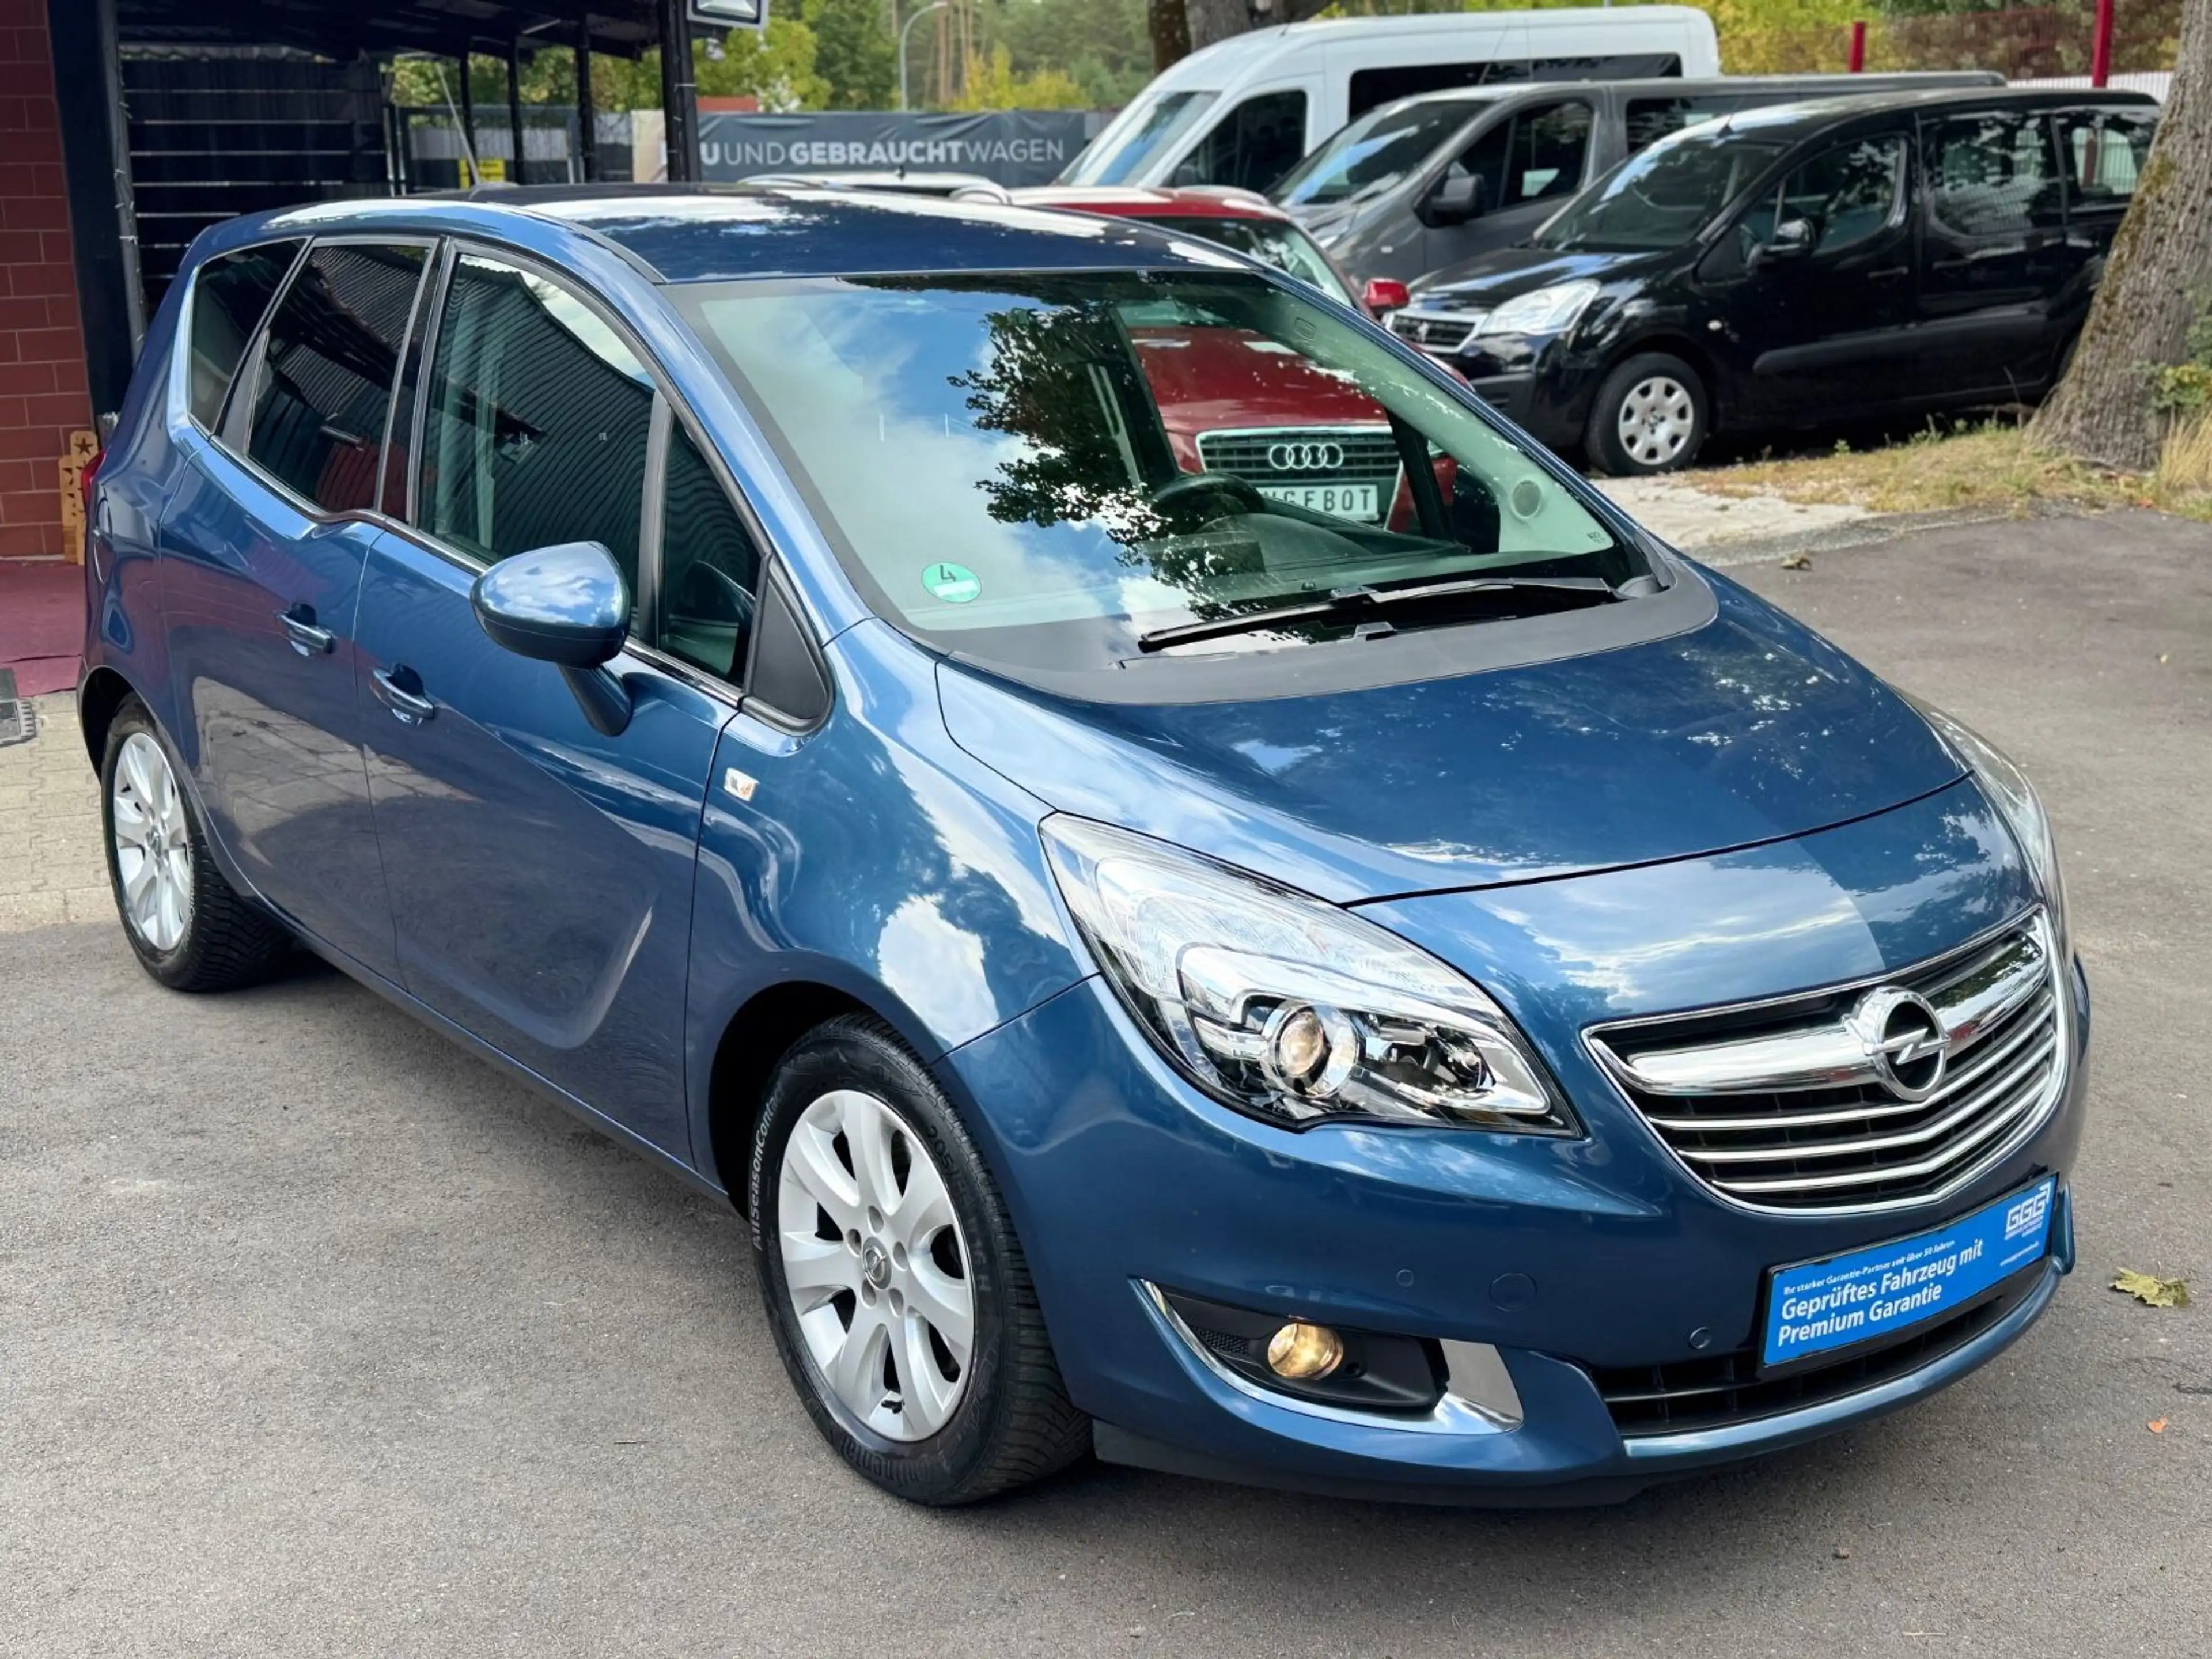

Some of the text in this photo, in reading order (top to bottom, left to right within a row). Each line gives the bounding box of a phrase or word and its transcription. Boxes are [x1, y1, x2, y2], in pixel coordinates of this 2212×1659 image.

[1782, 1281, 1877, 1320] Geprüftes
[1880, 1254, 1957, 1295] Fahrzeug
[1959, 1238, 1983, 1266] mit
[1797, 1278, 1825, 1292] starker
[1826, 1261, 1891, 1285] Garantie-Partner
[1778, 1282, 1942, 1348] Premium Garantie
